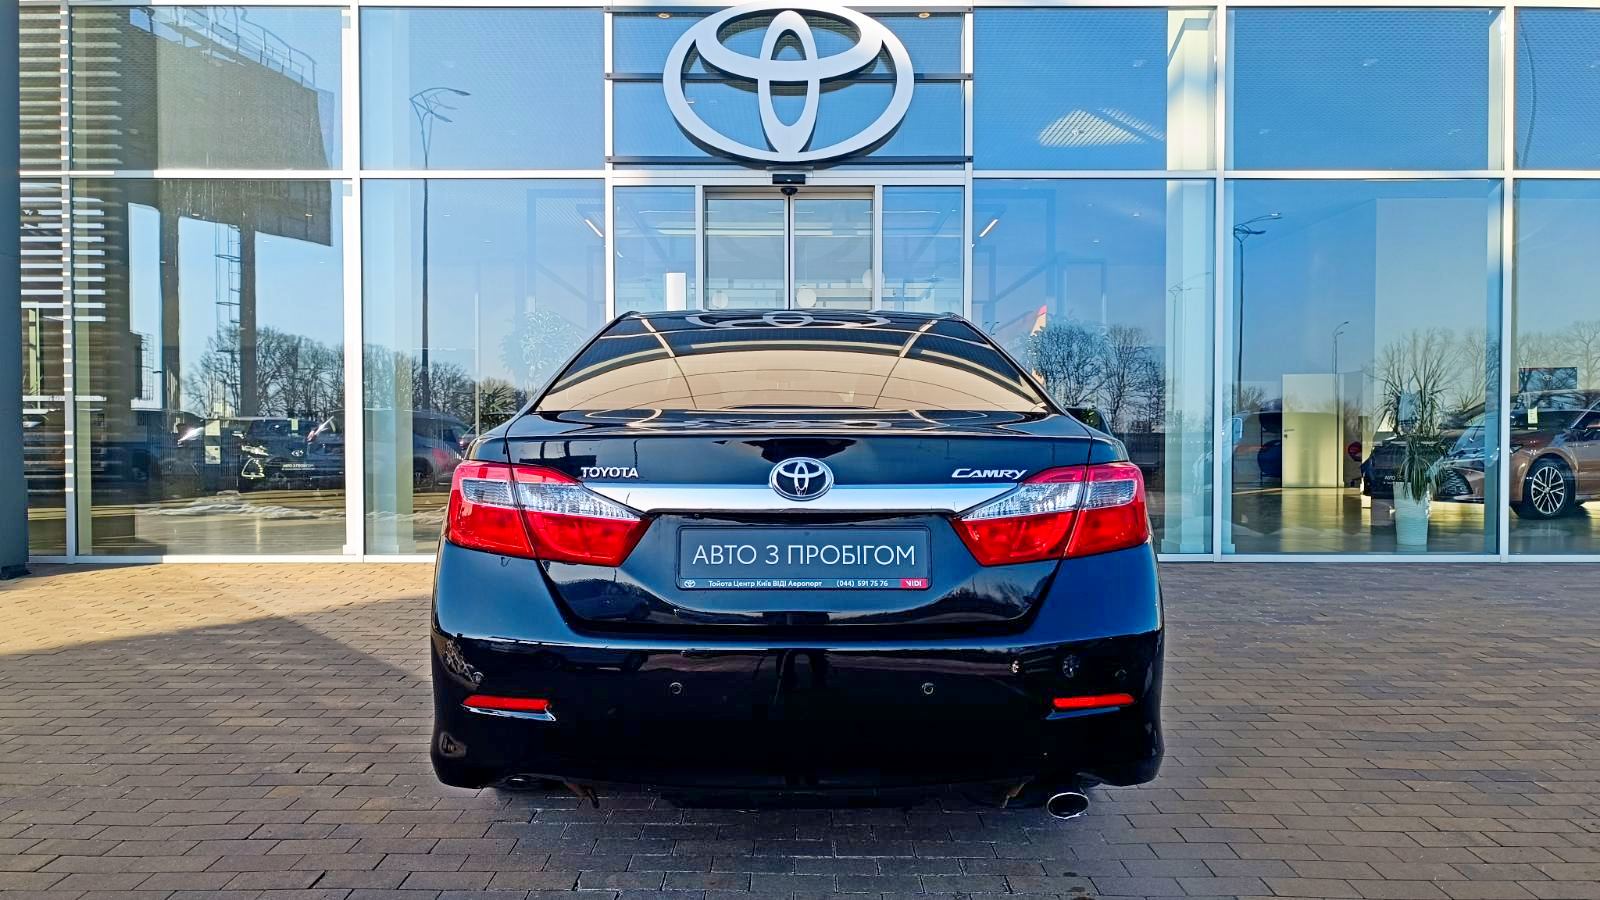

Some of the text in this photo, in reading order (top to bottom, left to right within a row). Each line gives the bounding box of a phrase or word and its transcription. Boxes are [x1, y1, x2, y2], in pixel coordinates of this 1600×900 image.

[580, 466, 639, 478] TOYOTA
[951, 468, 1028, 480] CAMRY
[692, 545, 757, 565] АВТО
[787, 545, 915, 565] ПРОБІГОМ
[733, 580, 755, 588] Центр
[756, 579, 771, 587] Київ
[787, 580, 822, 588] Аеропорт
[836, 579, 889, 588] (044) 591 75 76
